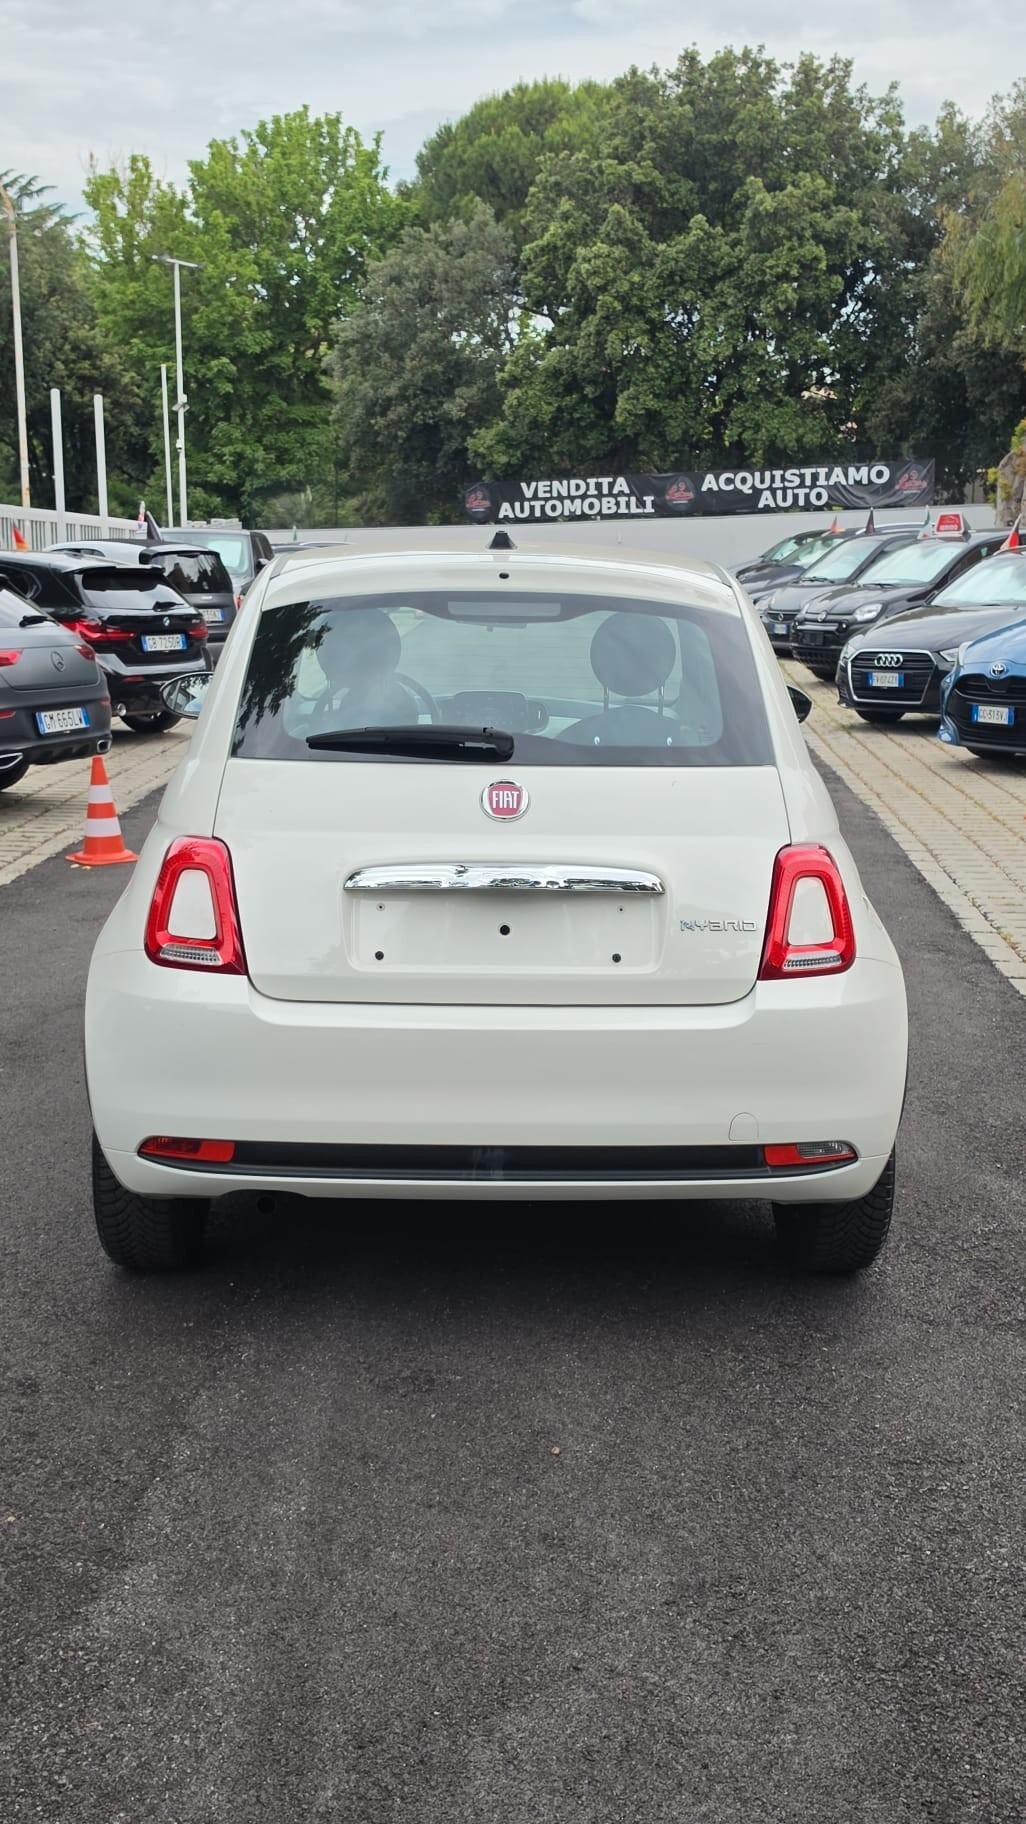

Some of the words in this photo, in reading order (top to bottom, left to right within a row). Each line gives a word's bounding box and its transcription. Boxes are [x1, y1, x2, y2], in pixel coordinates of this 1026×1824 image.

[520, 476, 630, 498] VENDITA
[701, 465, 890, 493] ACQUISTIAMO
[498, 495, 655, 519] AUTOMOBILI
[757, 487, 829, 508] AUTO
[492, 790, 520, 809] FIAT
[680, 919, 757, 932] HYBRID
